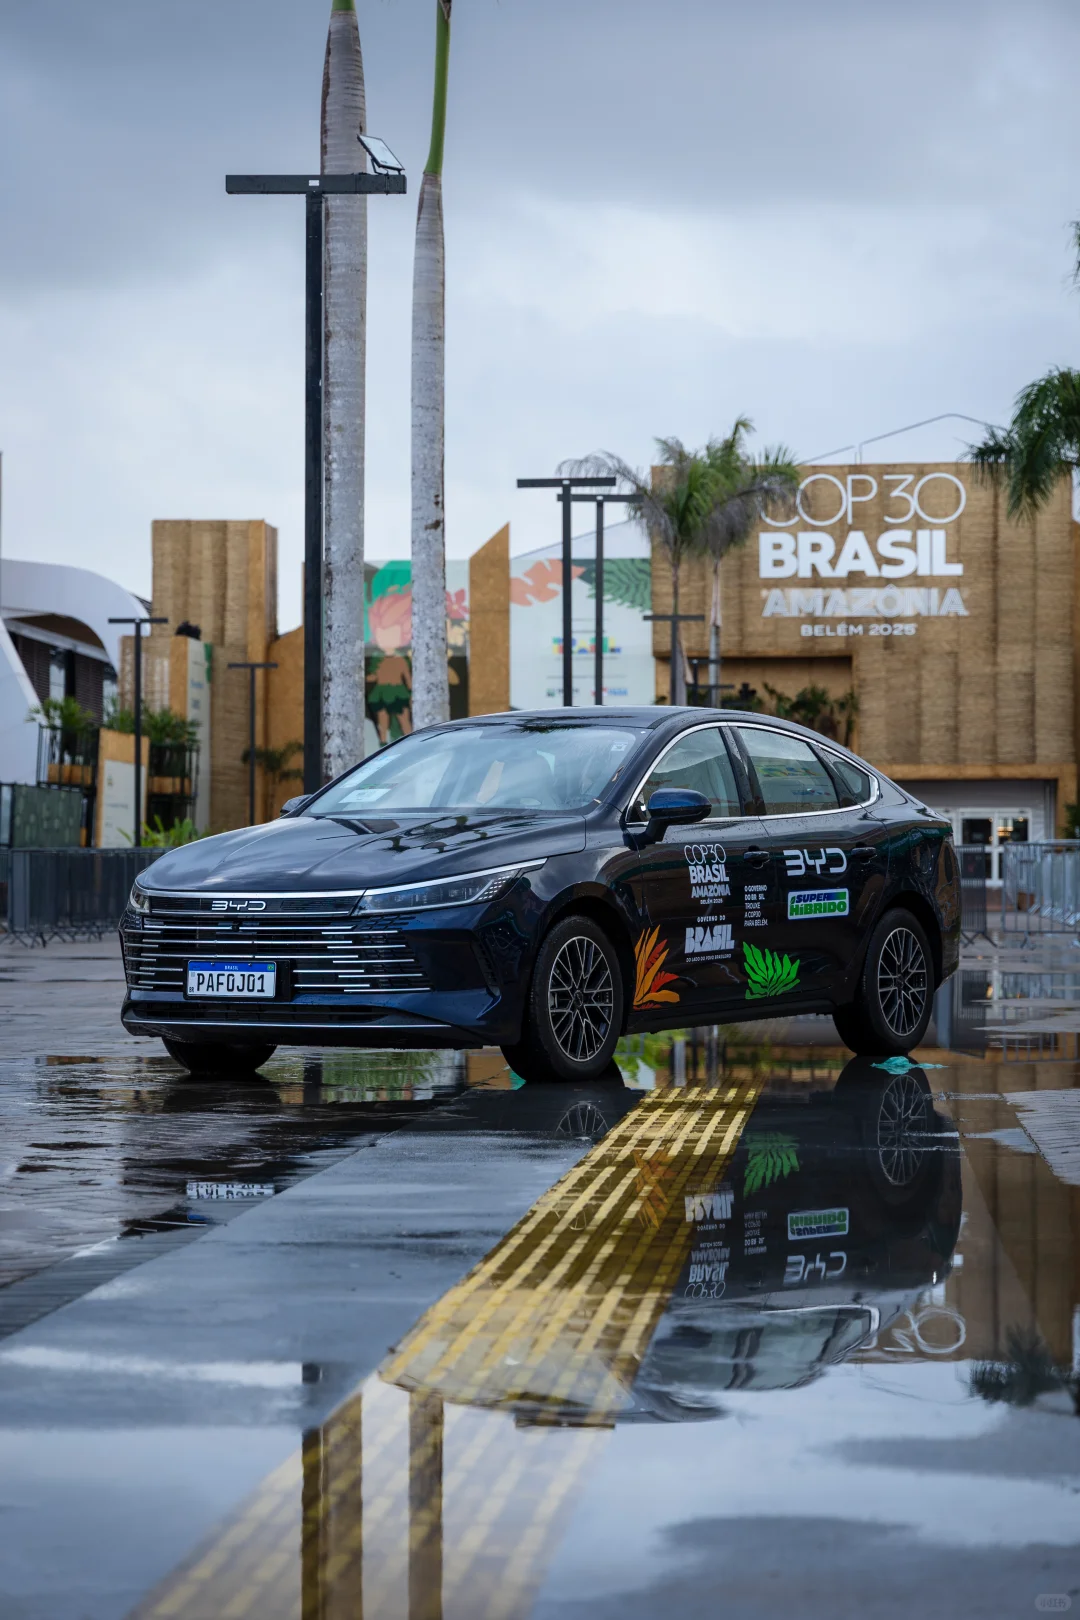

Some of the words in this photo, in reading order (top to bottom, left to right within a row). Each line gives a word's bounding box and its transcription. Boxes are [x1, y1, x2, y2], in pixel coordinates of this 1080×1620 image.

[759, 529, 964, 579] BRASIL
[761, 583, 970, 618] AMAZÔNIA
[800, 621, 864, 636] BELÉM
[868, 623, 917, 636] 2025
[684, 844, 727, 865] COP30
[782, 847, 848, 877] BYD
[688, 864, 730, 884] BRASIL
[691, 883, 731, 899] AMAZÔNIA
[795, 892, 830, 904] SUPER
[211, 900, 267, 911] BYD
[744, 901, 761, 910] TROUXE
[696, 915, 718, 923] GOVERNO
[684, 923, 735, 954] BRASIL
